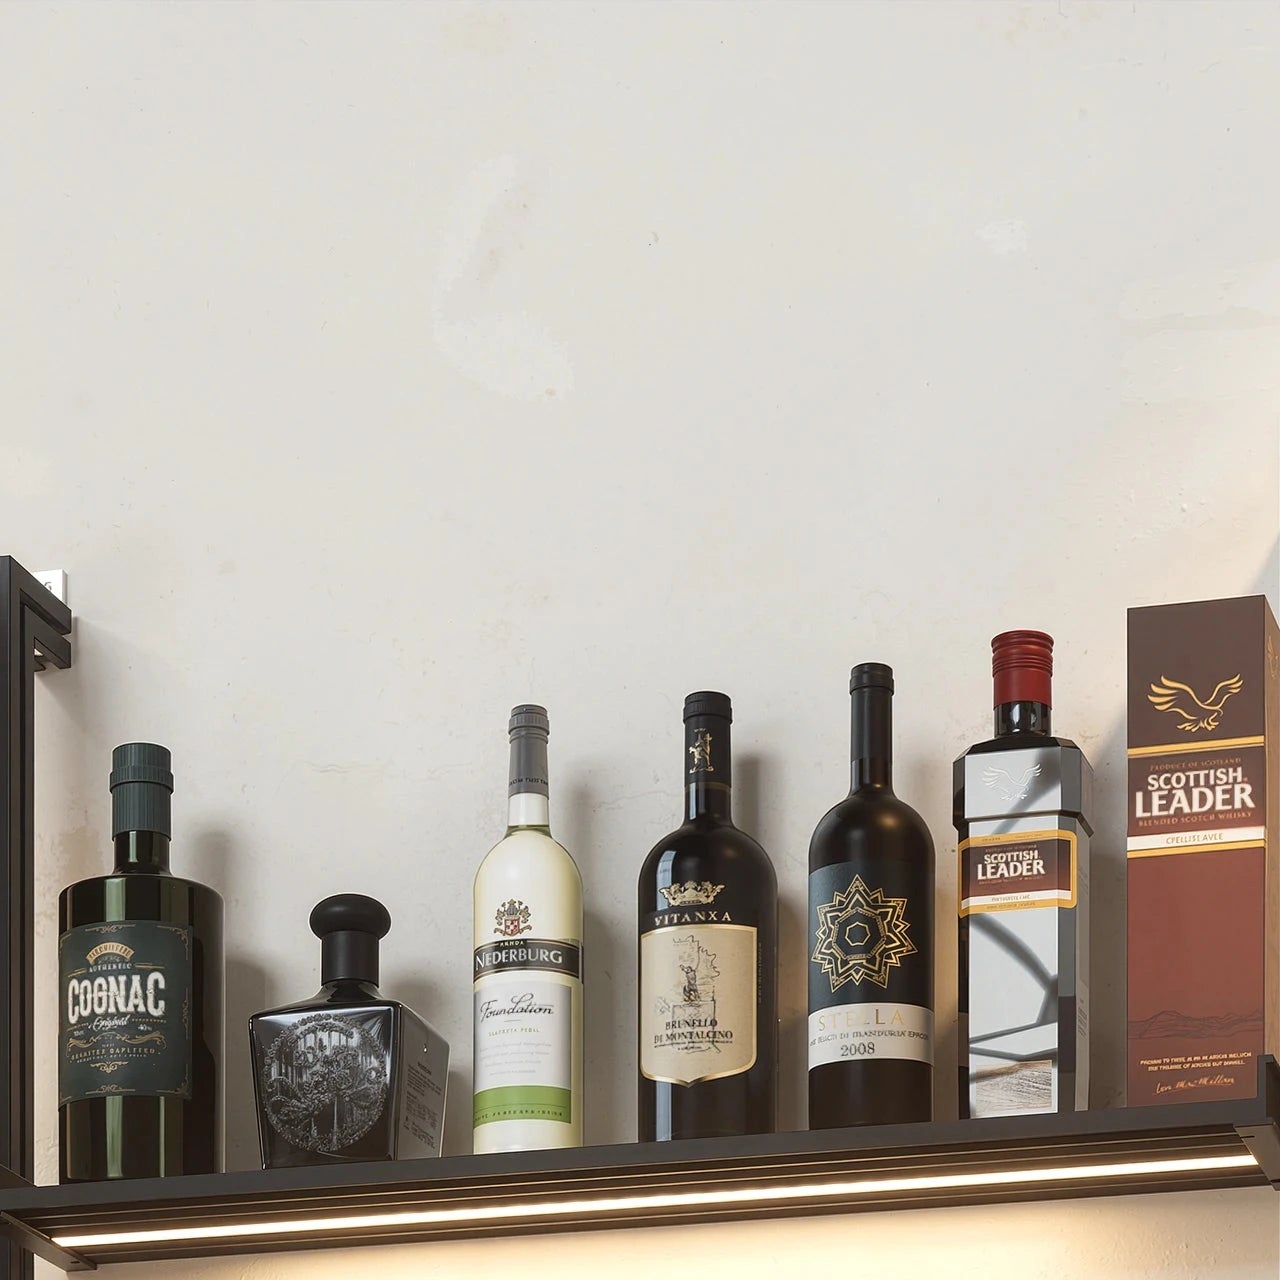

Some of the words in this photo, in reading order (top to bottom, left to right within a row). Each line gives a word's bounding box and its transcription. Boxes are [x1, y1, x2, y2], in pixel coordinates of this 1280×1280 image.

[1147, 766, 1242, 791] SCOTTISH
[1135, 783, 1256, 818] LEADER
[984, 849, 1039, 865] SCOTTISH
[977, 859, 1046, 880] LEADER
[654, 910, 732, 926] VITANXA
[475, 948, 563, 972] NEDERBURG
[67, 971, 166, 1025] COGNAC
[480, 992, 554, 1023] Foundation
[840, 1042, 875, 1057] 2008
